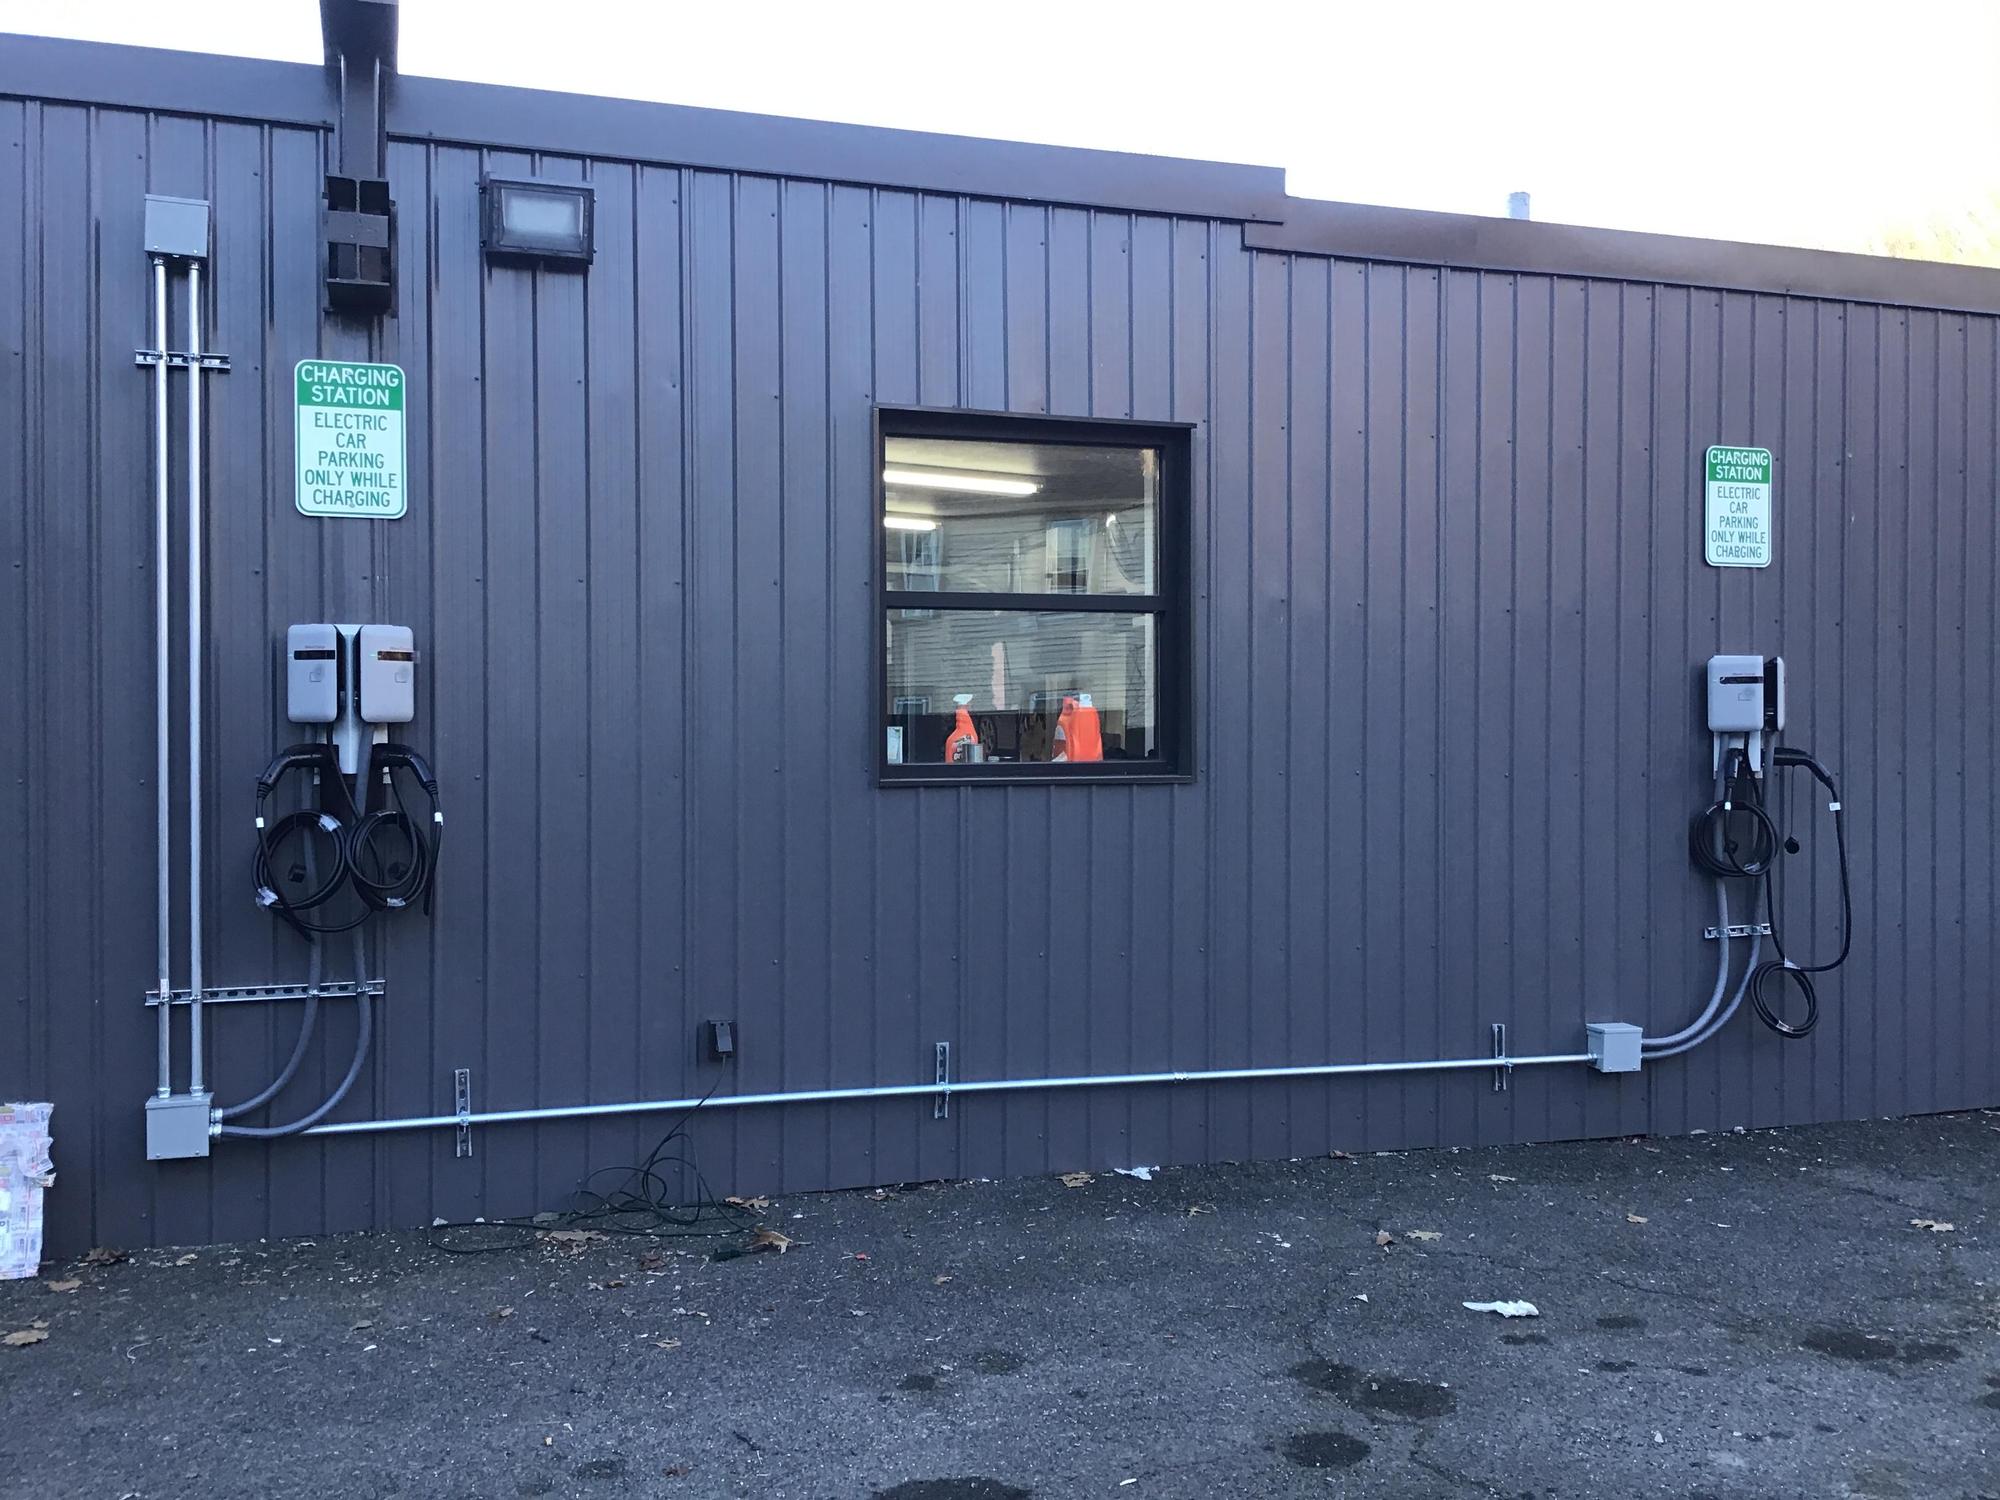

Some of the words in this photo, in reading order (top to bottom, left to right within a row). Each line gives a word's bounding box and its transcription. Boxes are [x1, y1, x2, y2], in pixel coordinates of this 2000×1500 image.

[301, 365, 399, 387] CHARGING
[312, 385, 389, 406] STATION
[314, 412, 388, 431] ELECTRIC
[335, 432, 366, 449] CAR
[318, 450, 384, 469] PARKING
[1710, 450, 1768, 466] CHARGING
[304, 469, 344, 486] ONLY
[350, 471, 397, 489] WHILE
[1715, 465, 1762, 480] STATION
[313, 488, 390, 508] CHARGING
[1717, 486, 1761, 500] ELECTRIC
[1729, 501, 1748, 514] CAR
[1719, 515, 1759, 529] PARKING
[1711, 530, 1735, 543] ONLY
[1737, 531, 1766, 544] WHILE
[1715, 544, 1762, 559] CHARGING
